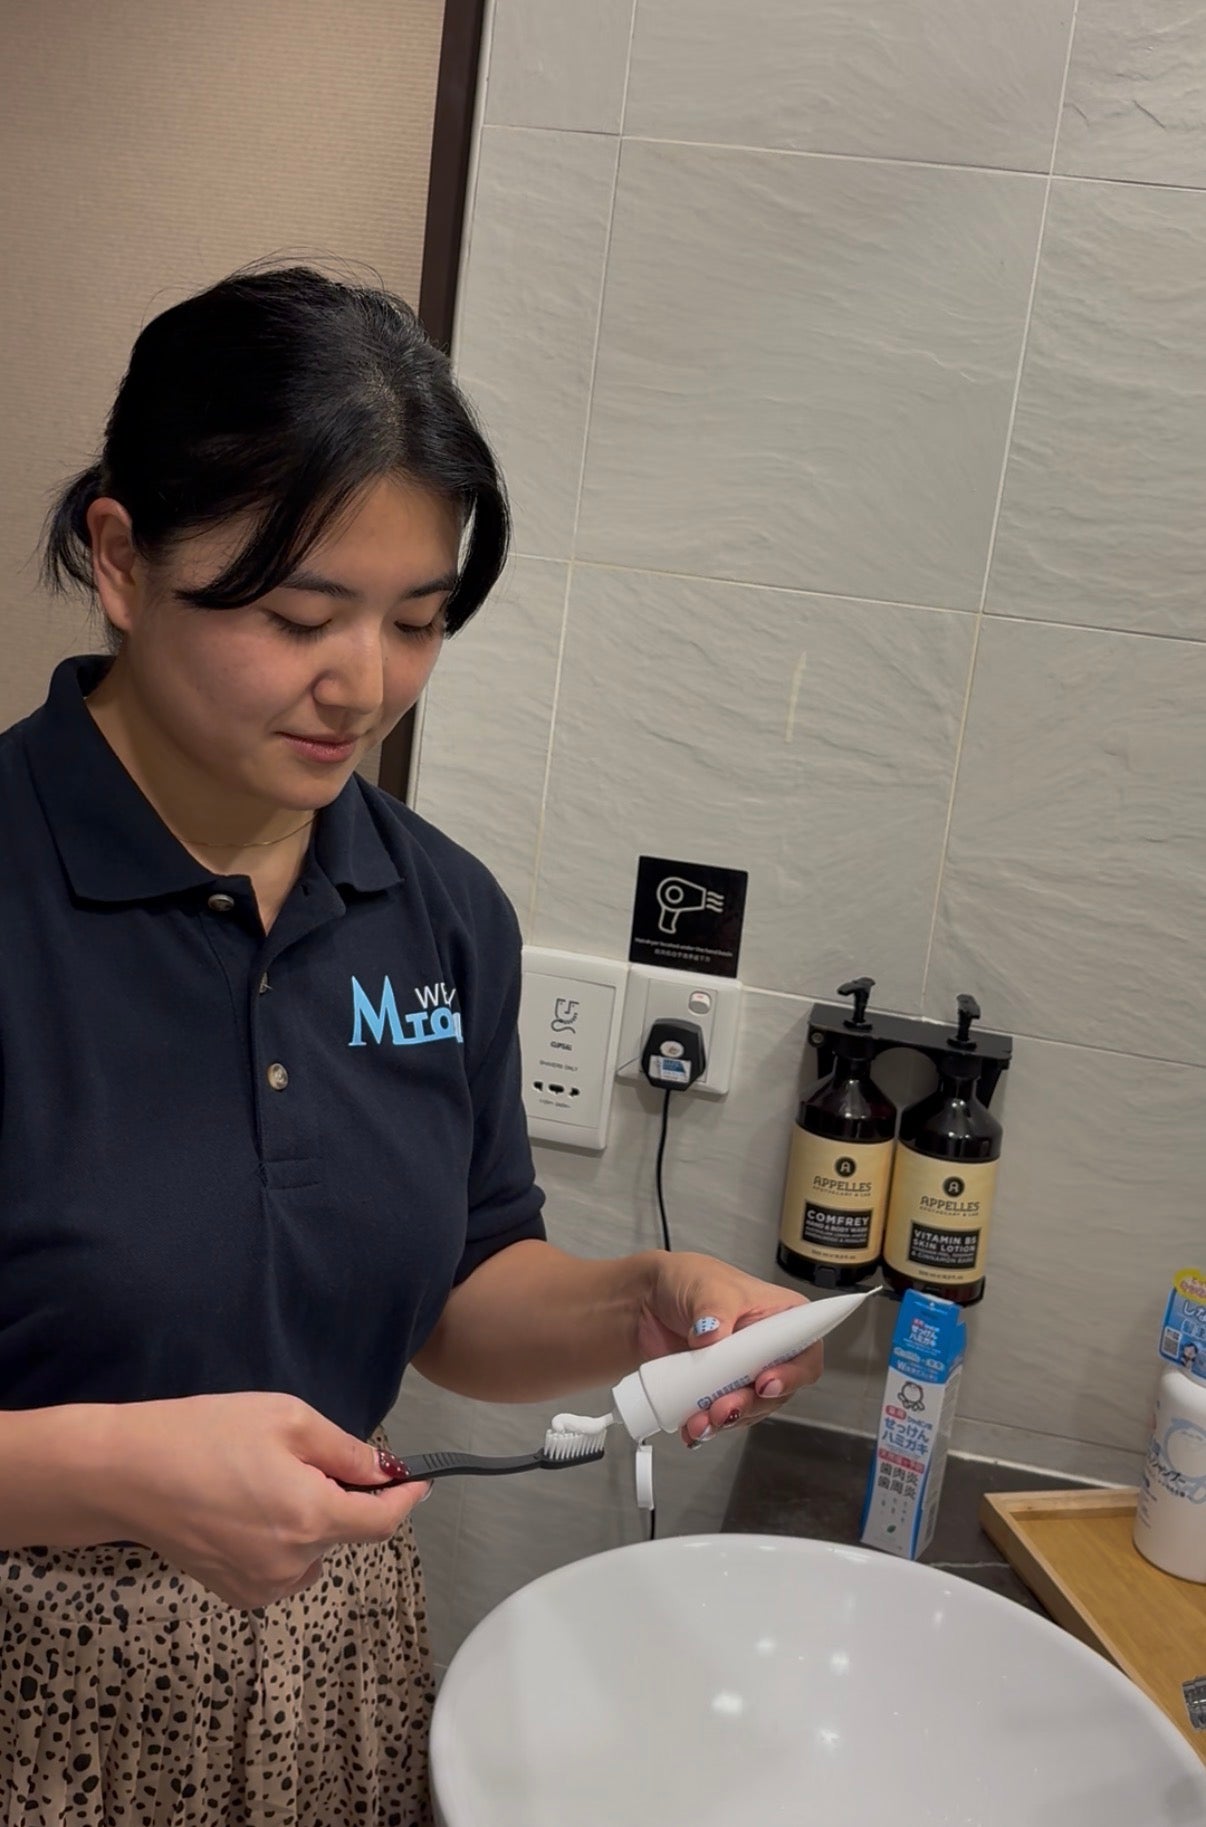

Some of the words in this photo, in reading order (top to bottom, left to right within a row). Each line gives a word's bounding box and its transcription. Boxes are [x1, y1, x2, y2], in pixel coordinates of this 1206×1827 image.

[839, 1161, 851, 1174] A
[813, 1175, 872, 1193] APPELLES
[948, 1180, 960, 1193] A
[920, 1195, 981, 1212] APPELLES
[807, 1209, 870, 1227] COMFREY
[913, 1238, 937, 1250] SKIN
[940, 1244, 975, 1253] LOTION
[914, 1229, 961, 1245] VITAMIN
[884, 1417, 930, 1443] せっけん
[882, 1430, 929, 1455] ハミガキ
[880, 1462, 919, 1487] 歯肉炎
